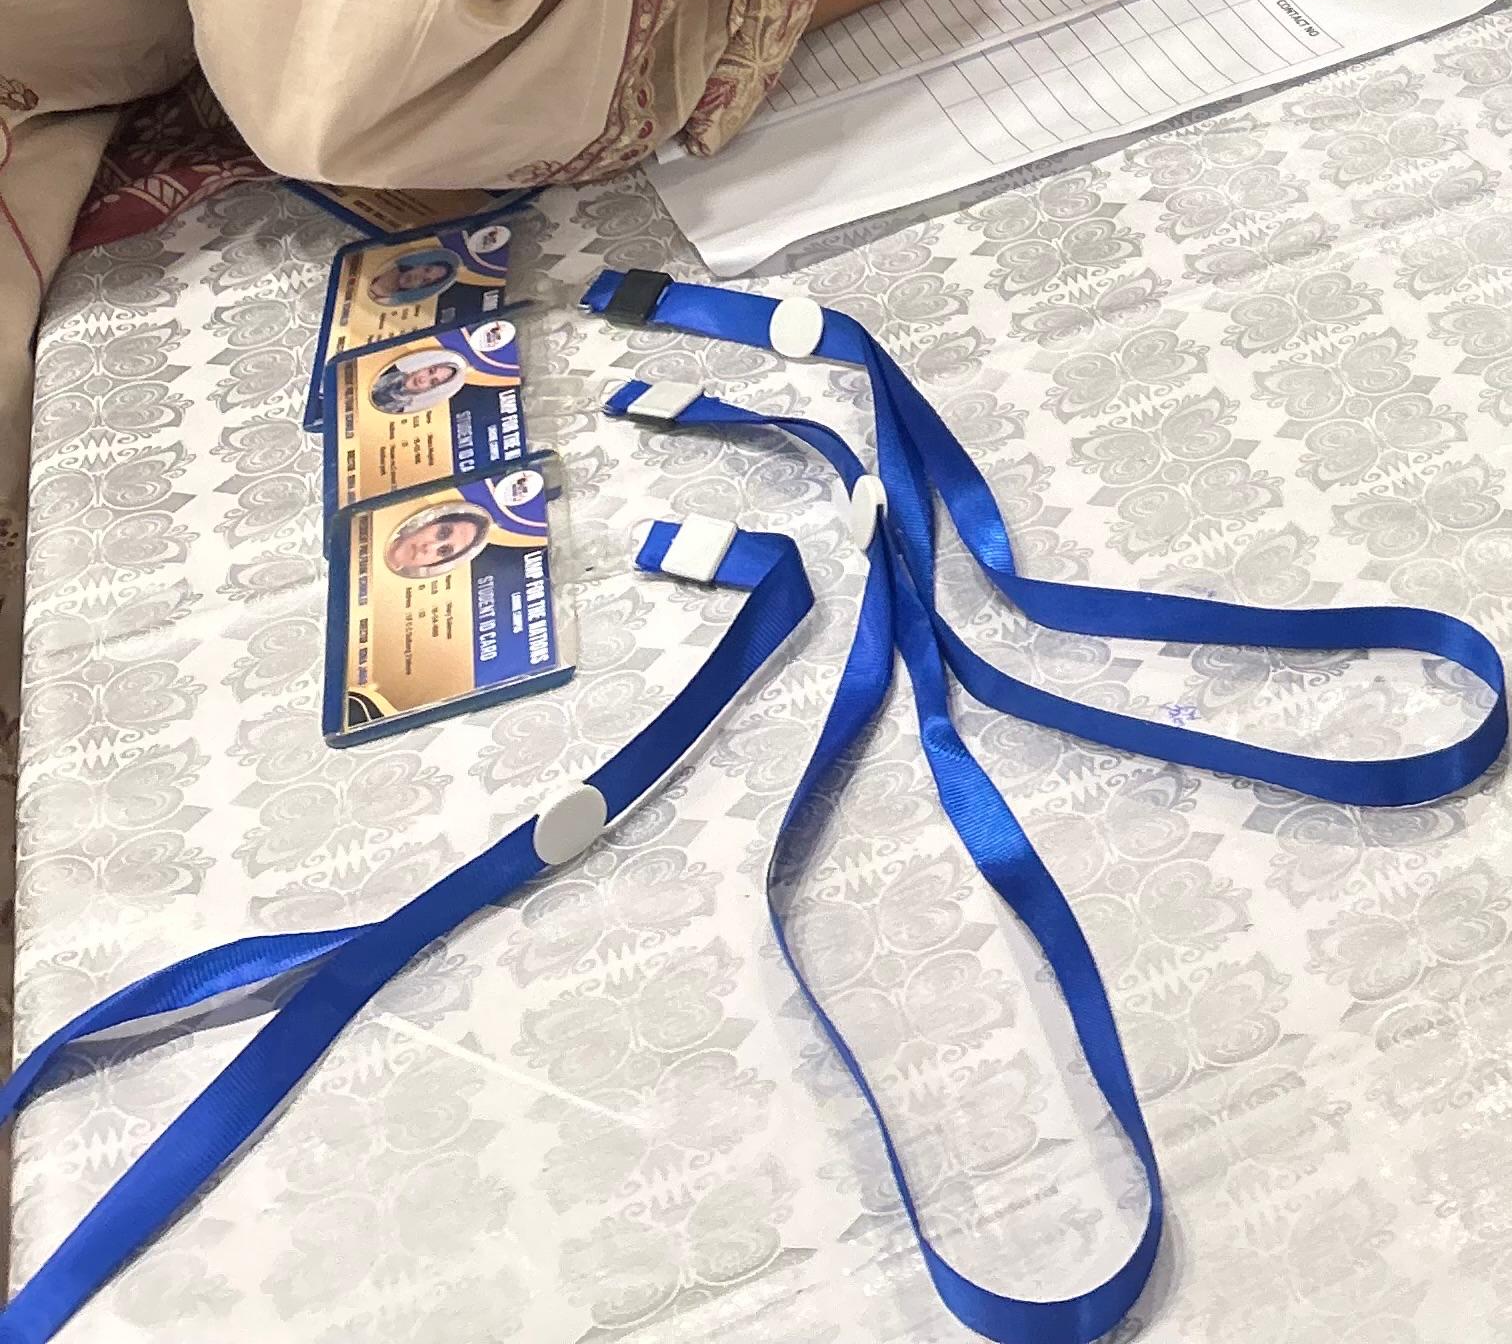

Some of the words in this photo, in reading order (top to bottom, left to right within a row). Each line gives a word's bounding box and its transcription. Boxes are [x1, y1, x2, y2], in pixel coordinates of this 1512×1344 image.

[1276, 0, 1310, 29] CONTACT
[524, 551, 544, 579] LAMP
[478, 576, 495, 619] STUDENT
[526, 579, 545, 601] FOR
[528, 599, 546, 623] THE
[479, 620, 496, 632] ID
[480, 632, 498, 661] CARD
[528, 620, 550, 665] NATIONS
